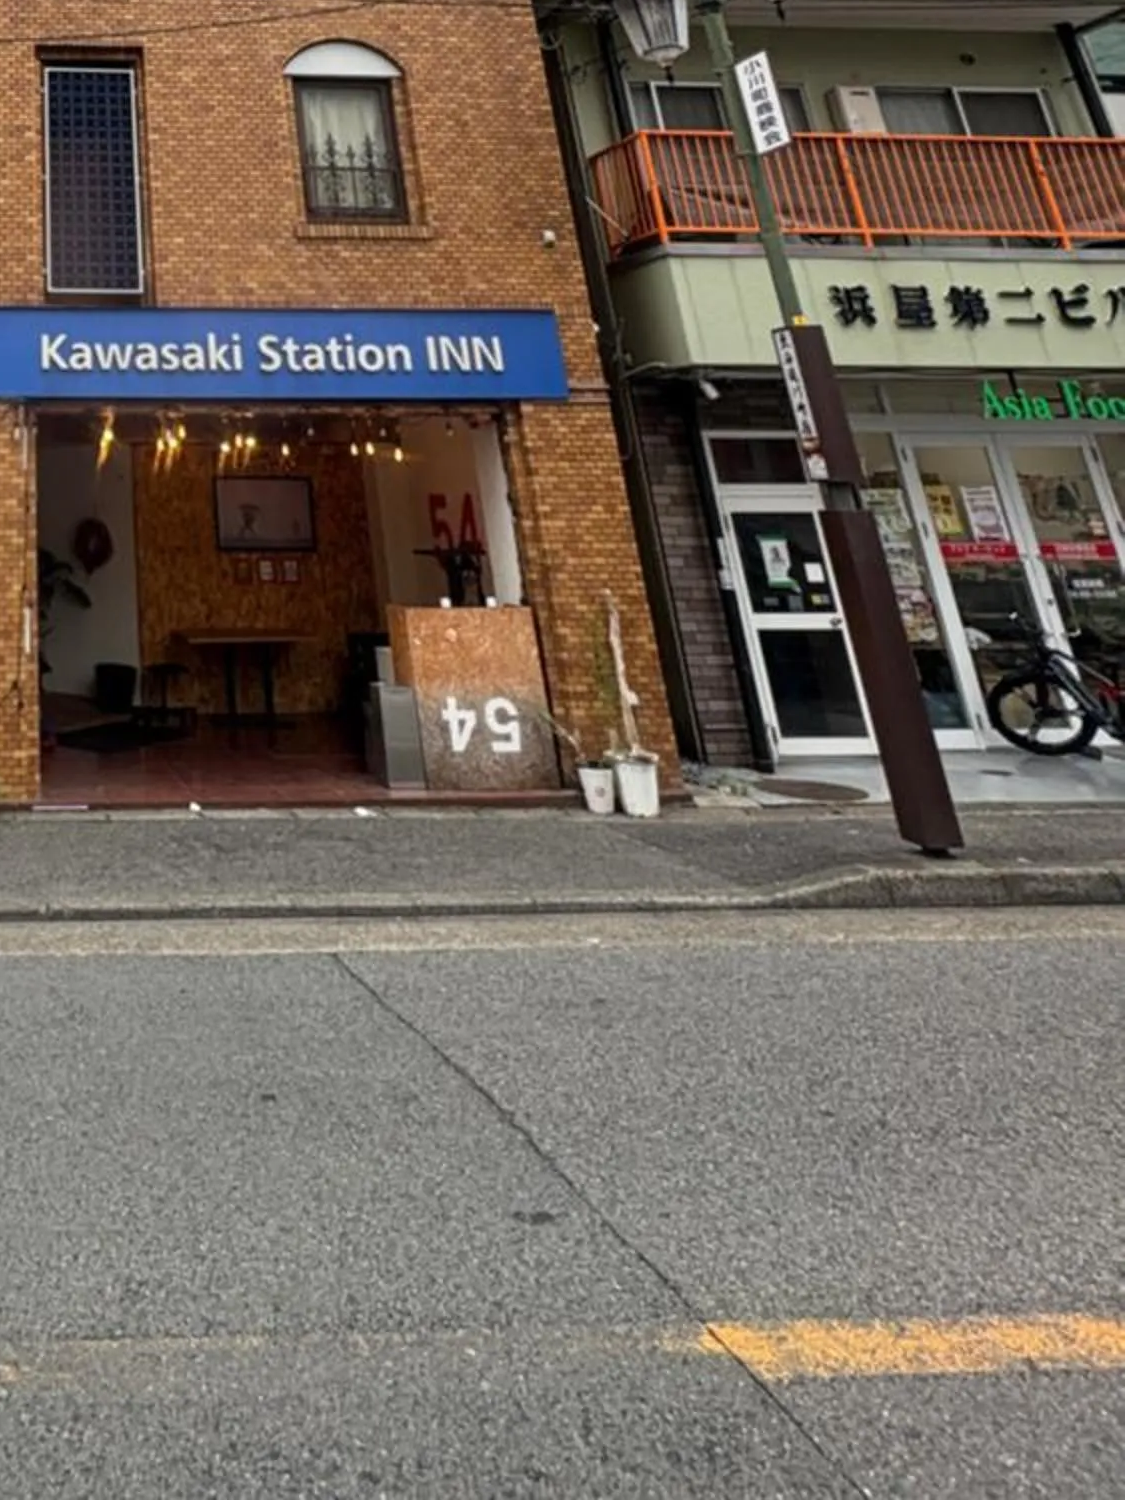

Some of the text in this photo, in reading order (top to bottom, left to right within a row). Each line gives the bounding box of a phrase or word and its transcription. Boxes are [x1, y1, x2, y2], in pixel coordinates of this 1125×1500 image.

[39, 332, 506, 372] Kawasaki Station INN
[982, 378, 1052, 421] Asia
[442, 695, 521, 752] 54
